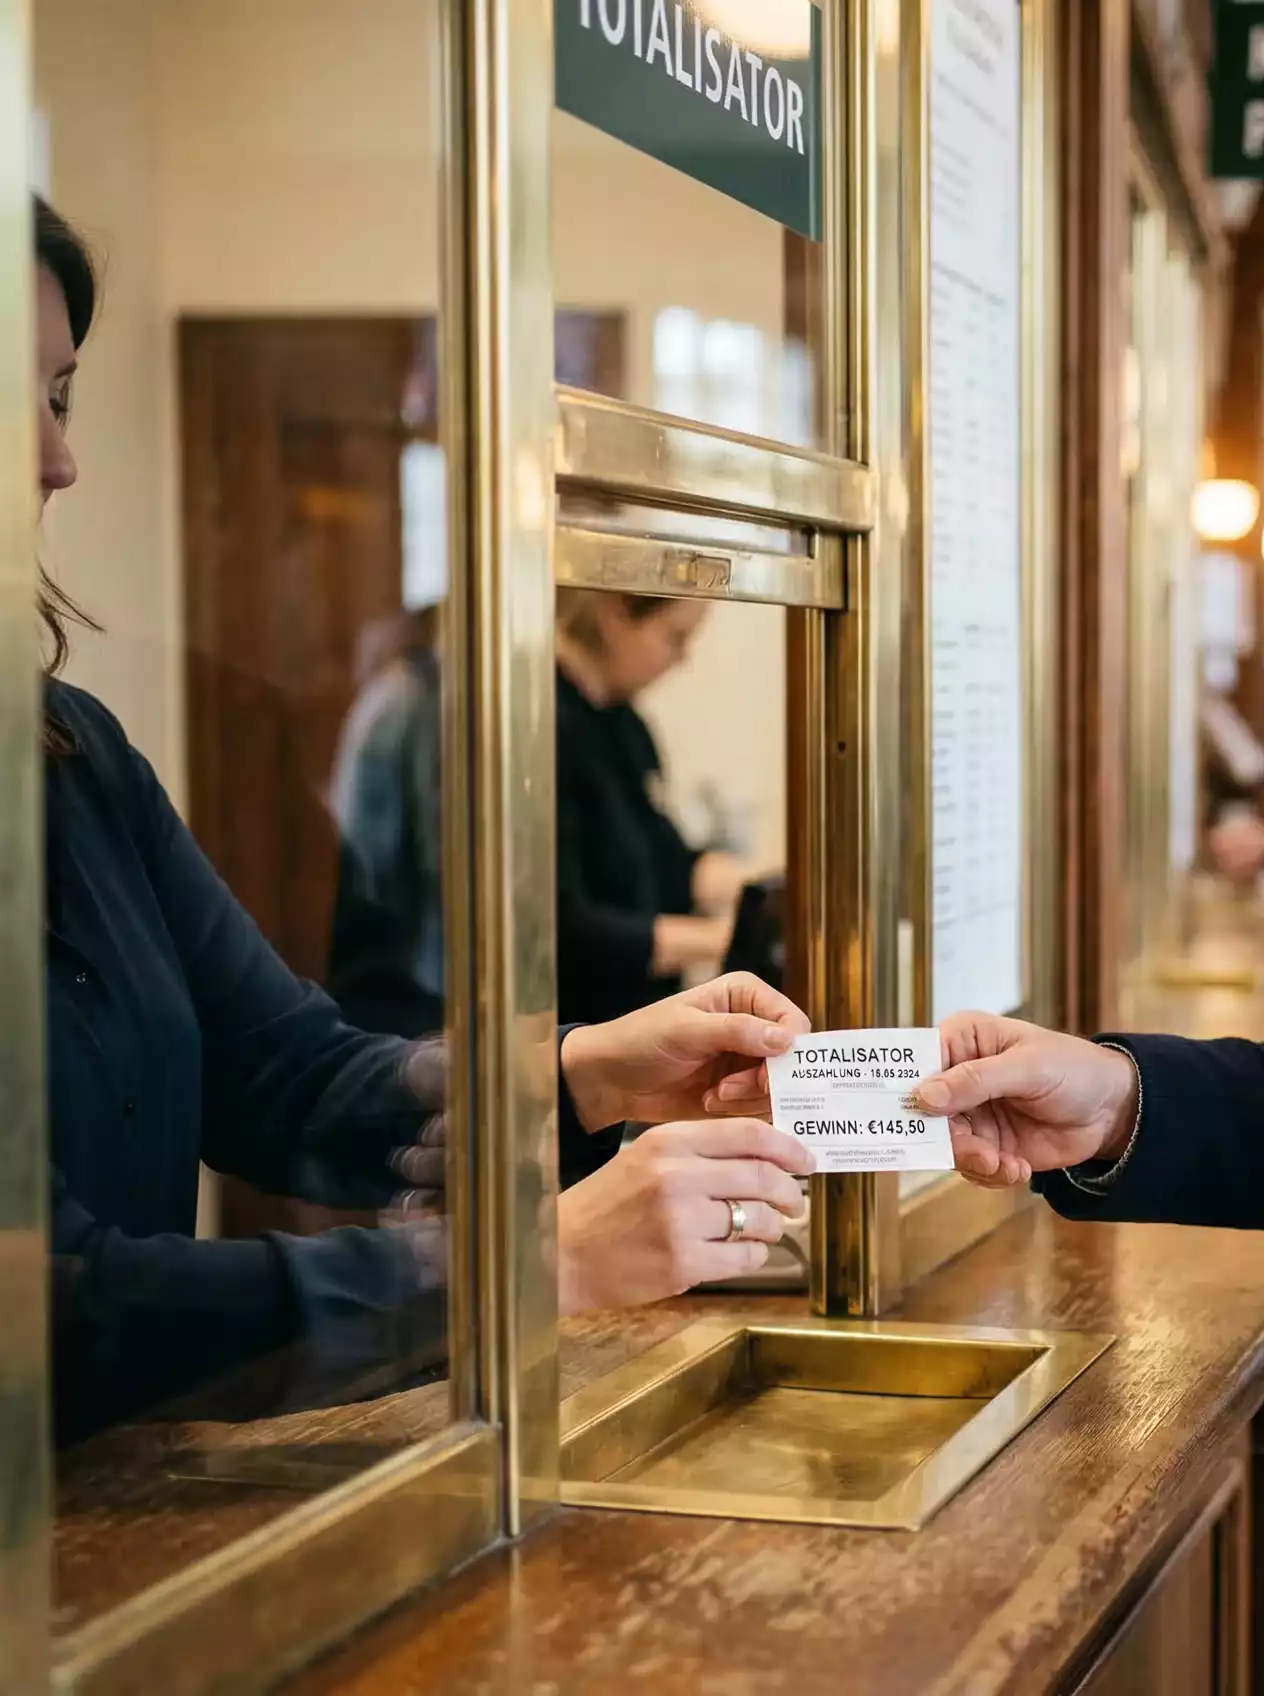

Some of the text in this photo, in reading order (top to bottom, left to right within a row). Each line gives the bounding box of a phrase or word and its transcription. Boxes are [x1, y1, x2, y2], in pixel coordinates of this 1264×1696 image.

[793, 1047, 915, 1064] TOTALISATOR
[791, 1068, 861, 1079] AUSZAHLUNG
[793, 1119, 926, 1137] GEWINN: €145,50
